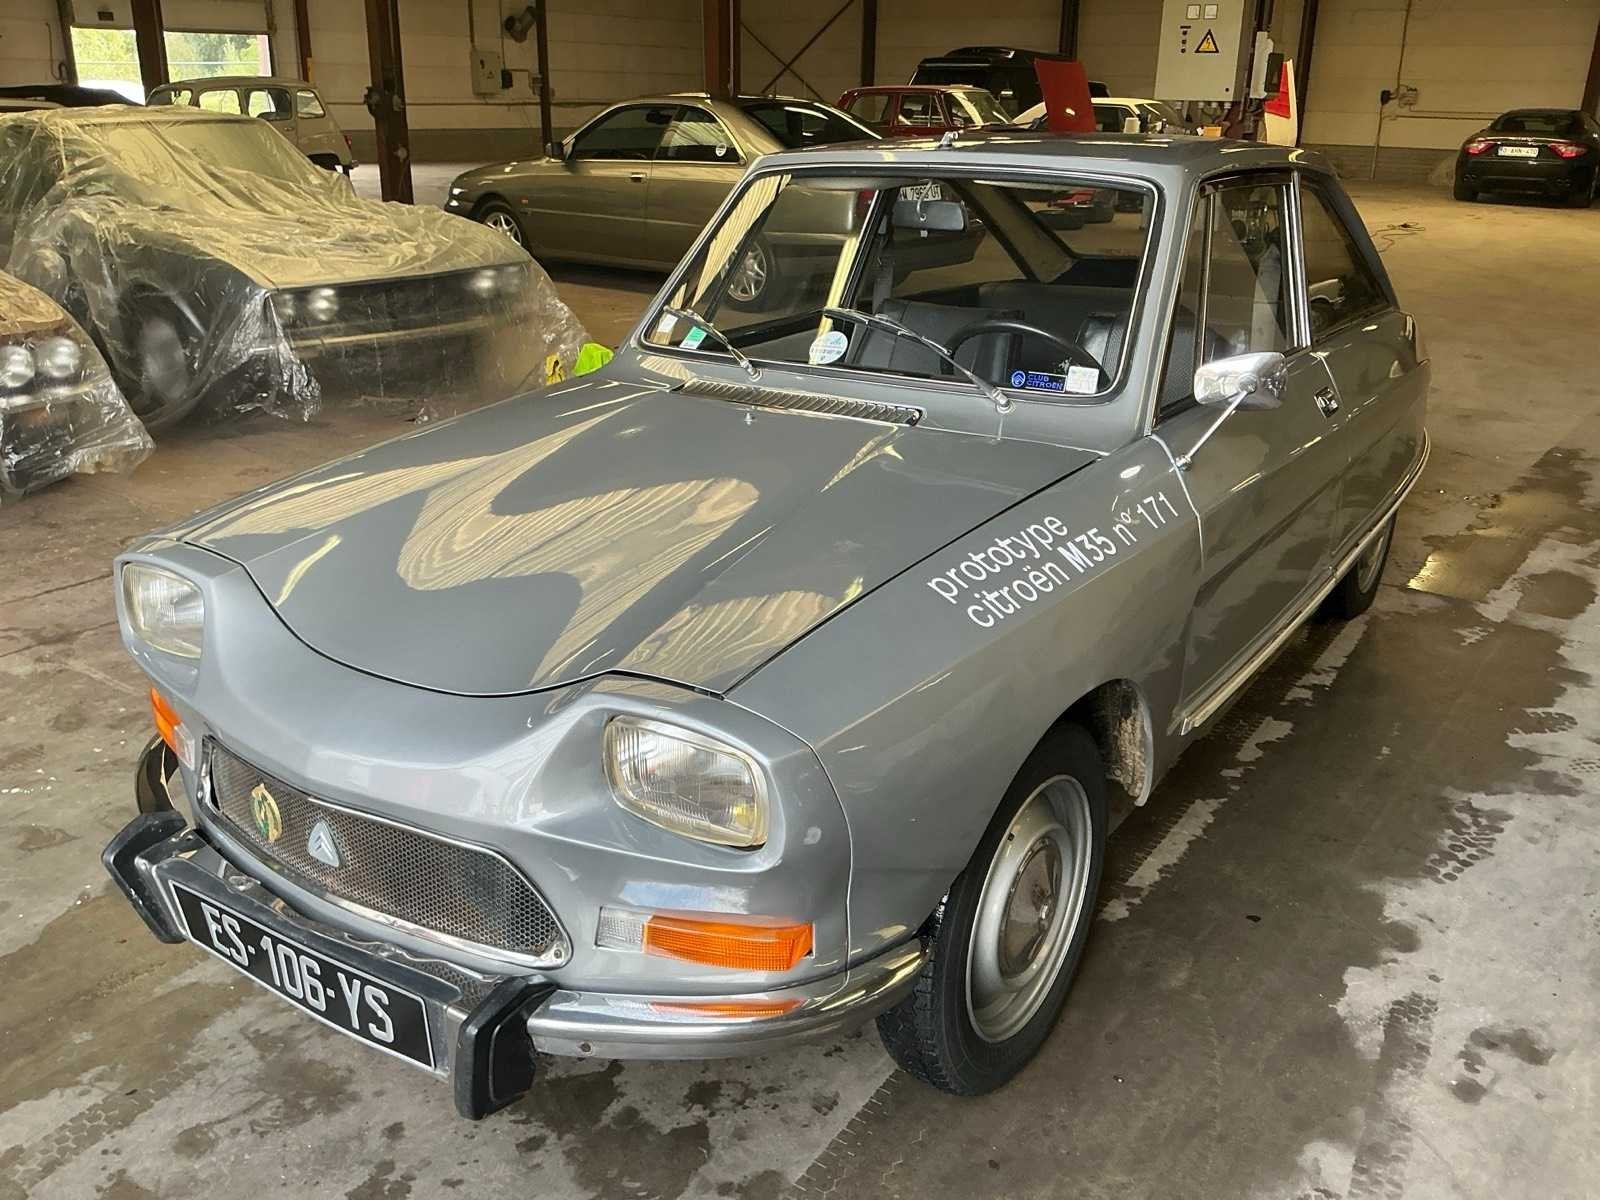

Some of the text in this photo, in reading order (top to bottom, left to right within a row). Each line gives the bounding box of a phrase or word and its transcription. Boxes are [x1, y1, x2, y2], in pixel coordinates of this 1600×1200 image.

[927, 516, 1068, 604] prototype
[967, 562, 1071, 628] citroën
[1057, 527, 1117, 573] M35
[1136, 491, 1179, 529] 171
[200, 901, 395, 1043] ES-106-YS
